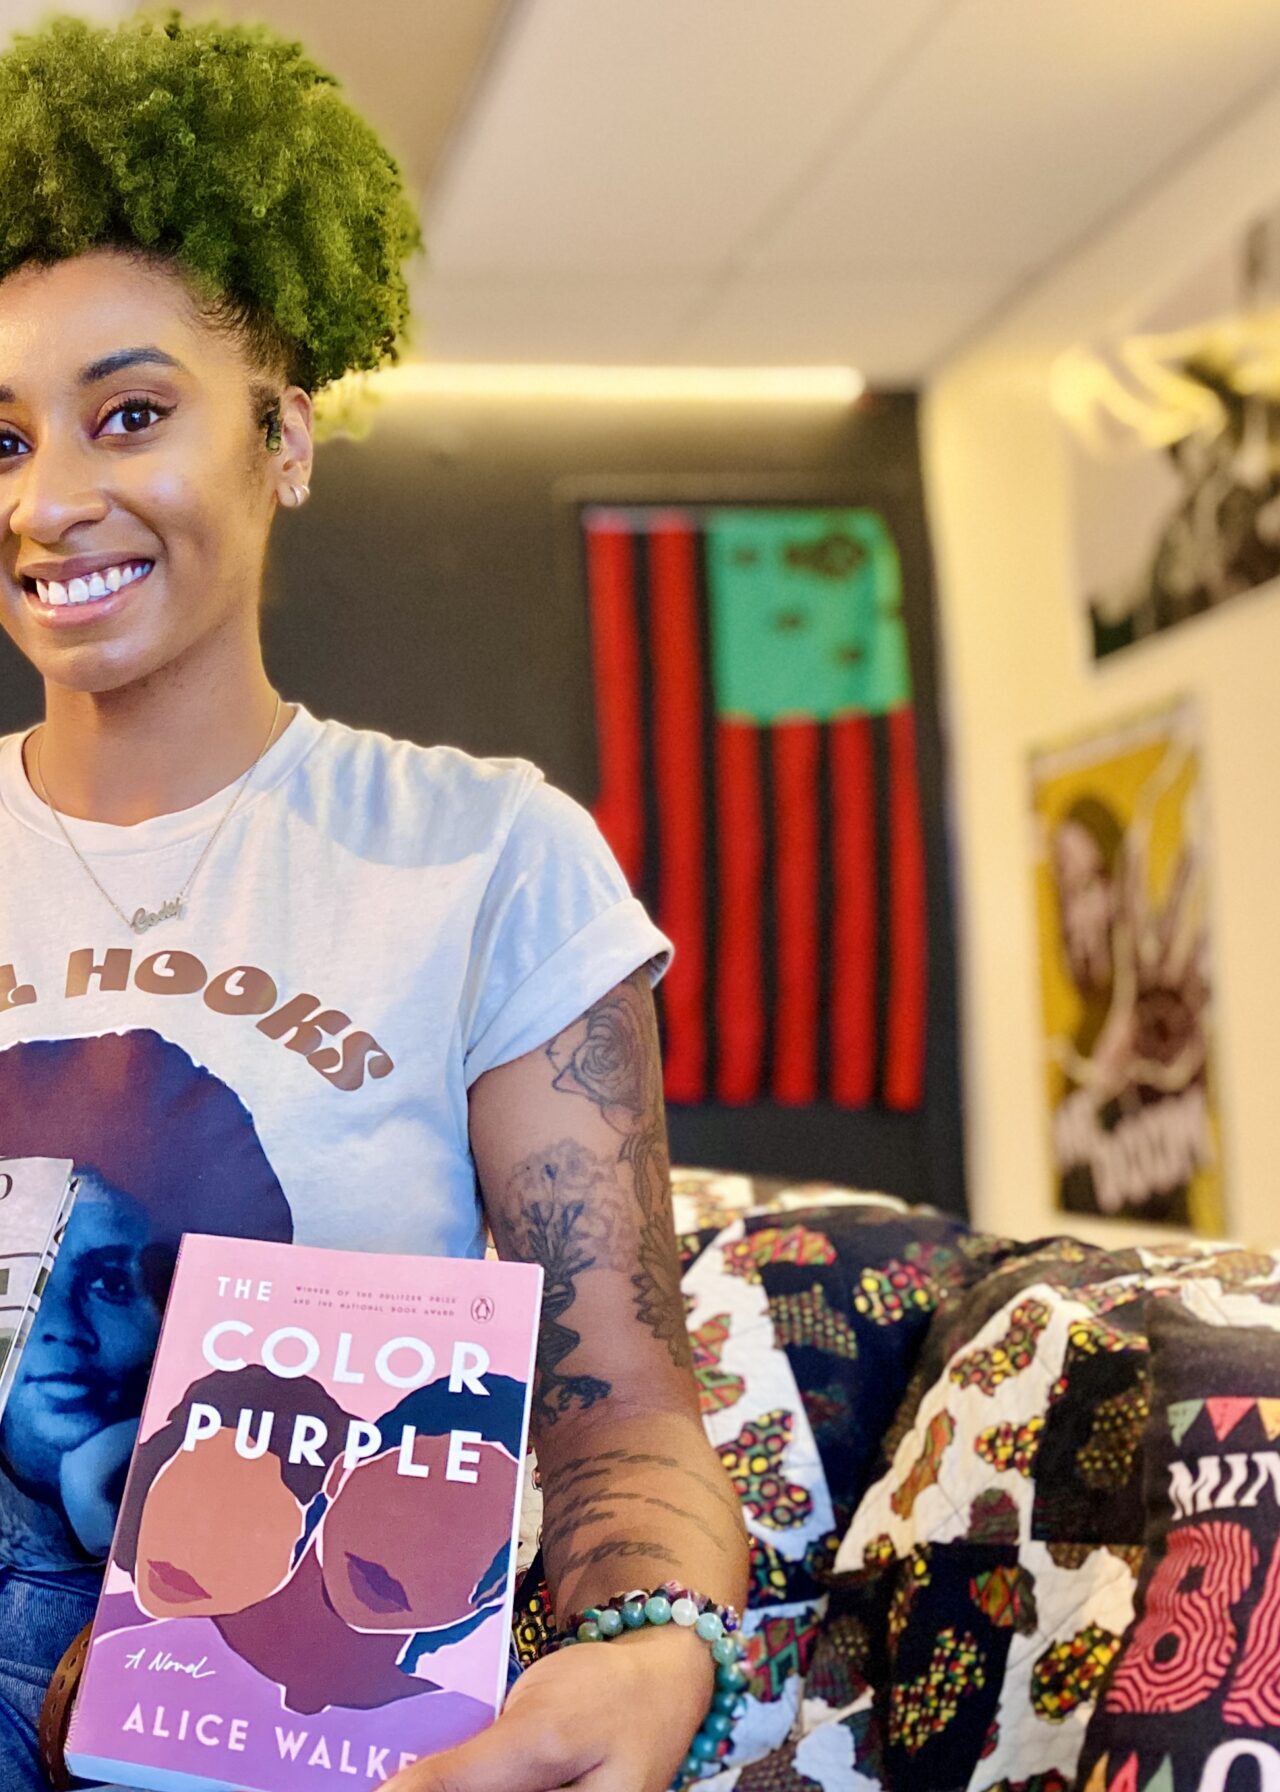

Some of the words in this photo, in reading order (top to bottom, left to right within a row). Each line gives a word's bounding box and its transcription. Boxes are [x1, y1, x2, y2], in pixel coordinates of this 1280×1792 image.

[65, 948, 394, 1091] HOOKS
[217, 1276, 272, 1302] THE
[295, 1285, 331, 1295] WINNER
[337, 1289, 350, 1297] OF
[391, 1305, 417, 1314] BOOK
[202, 1320, 490, 1396] COLOR
[182, 1402, 483, 1484] PURPLE
[124, 1648, 146, 1669] A
[148, 1651, 217, 1679] Novel
[122, 1702, 249, 1752] ALICE
[274, 1726, 418, 1781] WALKE
